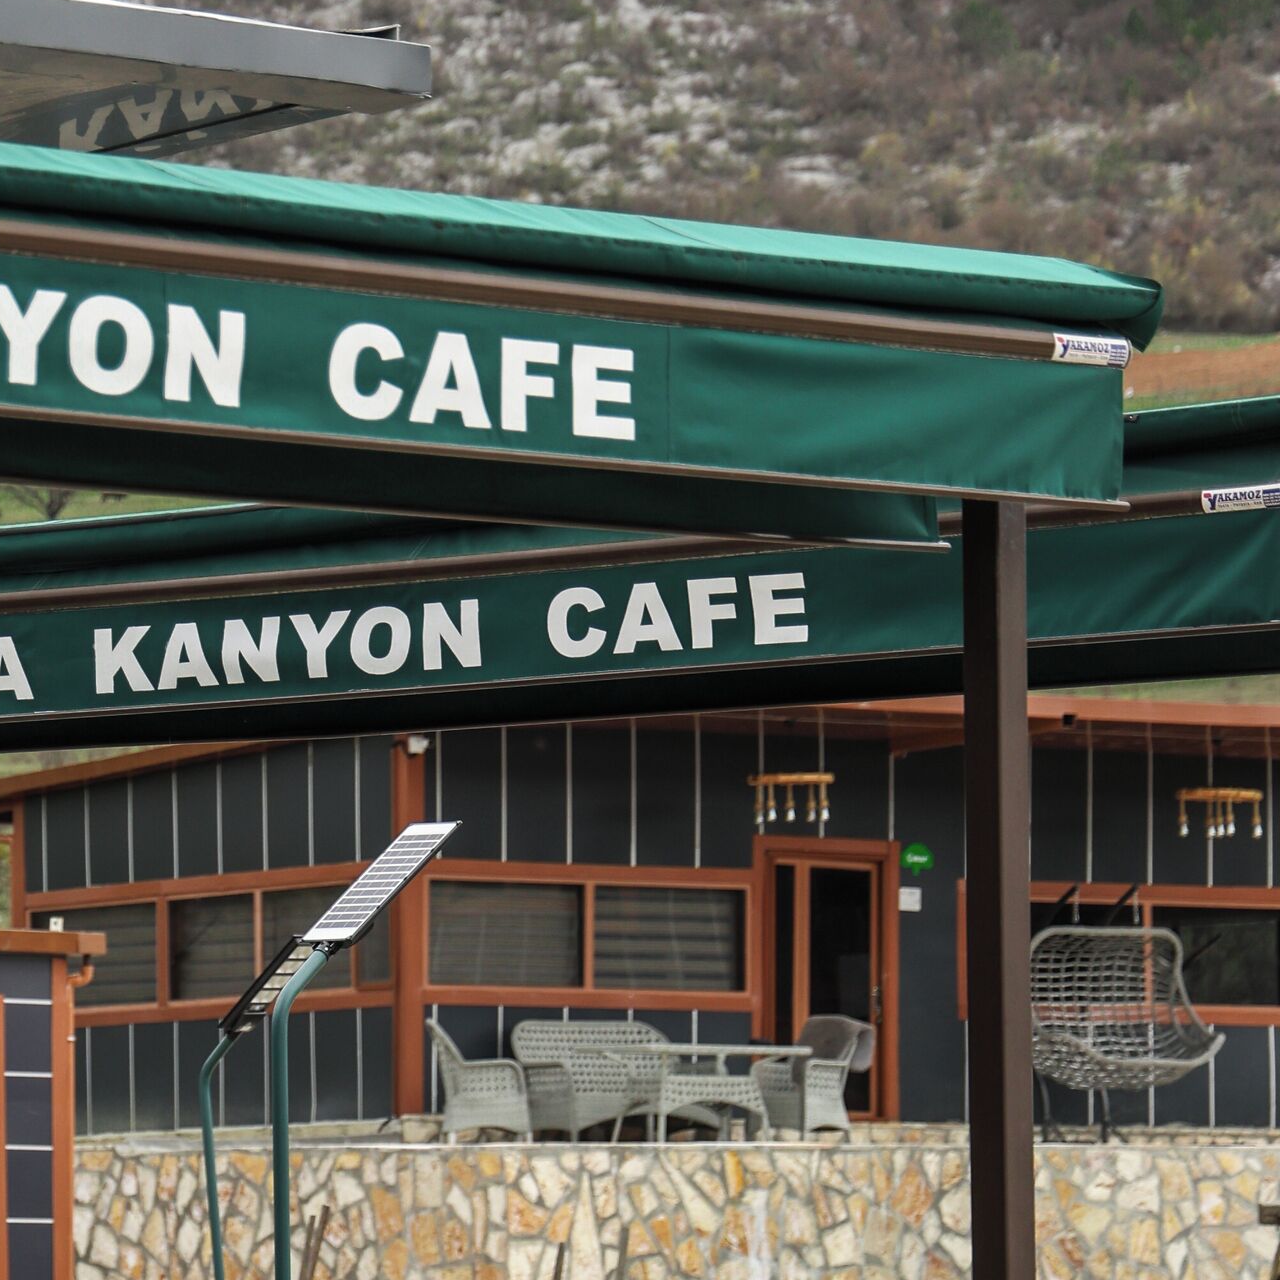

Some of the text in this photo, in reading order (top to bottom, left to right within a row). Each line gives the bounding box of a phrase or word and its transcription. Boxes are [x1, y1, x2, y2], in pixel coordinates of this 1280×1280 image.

[329, 323, 635, 440] CAFE
[1057, 338, 1110, 358] YAKAMOZ
[1204, 490, 1261, 510] YAKAMOZ
[94, 599, 481, 694] KANYON
[548, 573, 808, 657] CAFE
